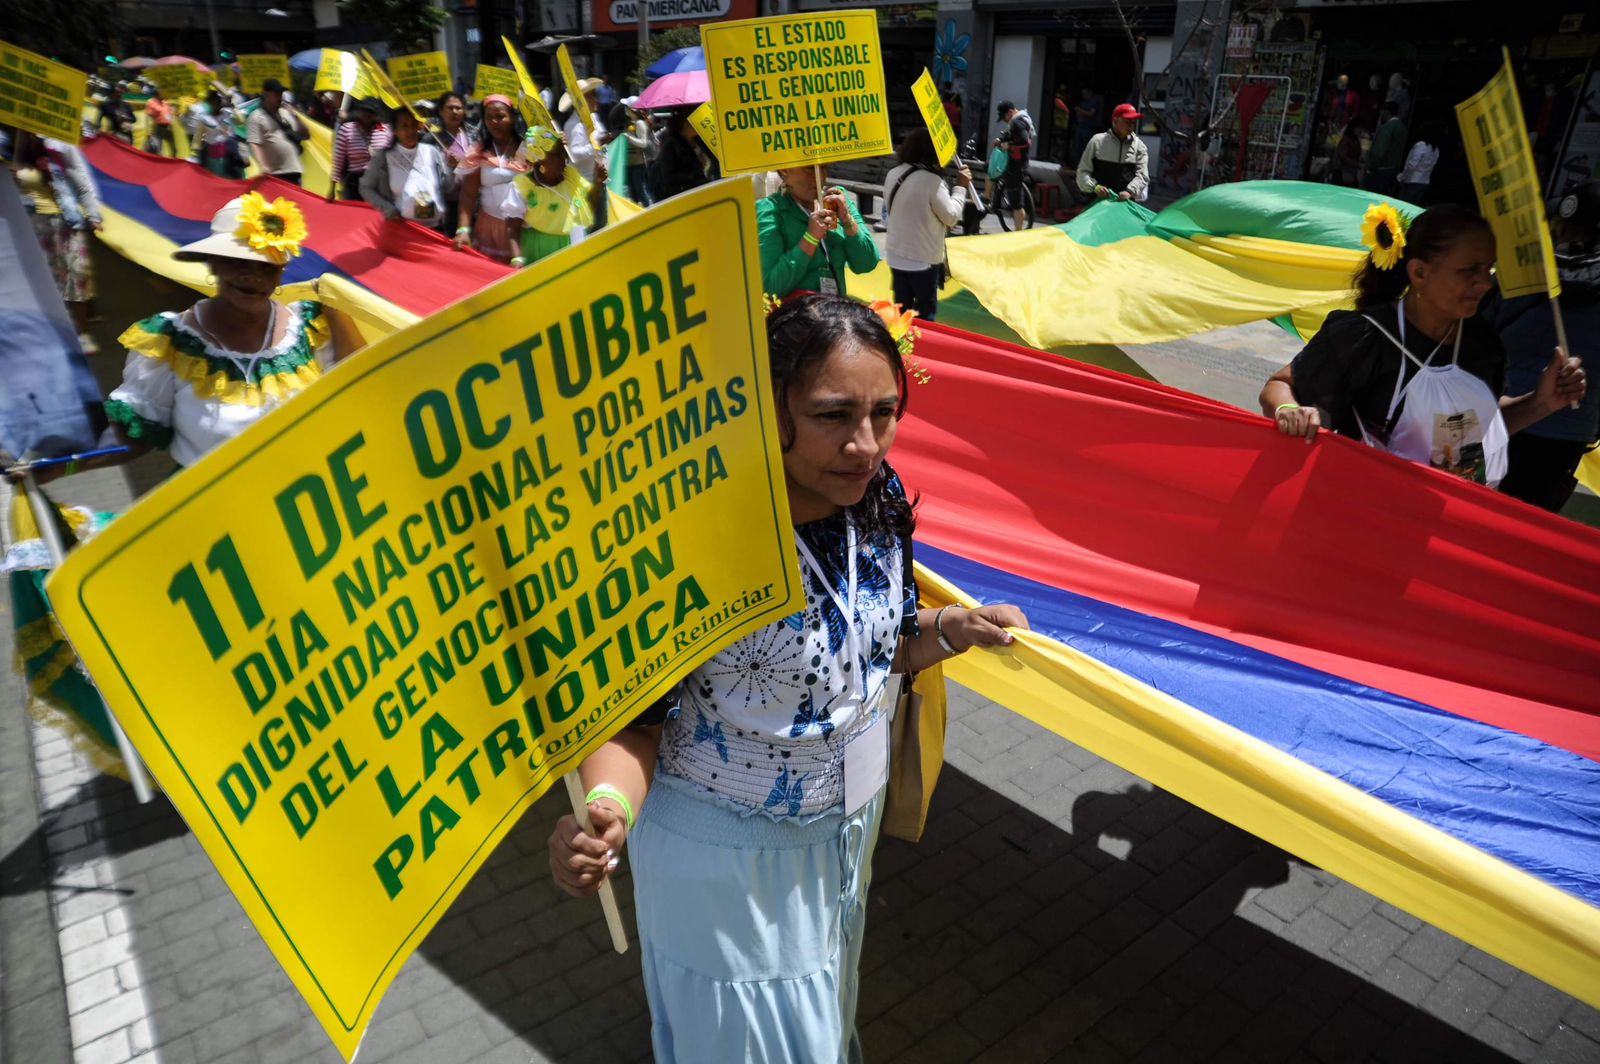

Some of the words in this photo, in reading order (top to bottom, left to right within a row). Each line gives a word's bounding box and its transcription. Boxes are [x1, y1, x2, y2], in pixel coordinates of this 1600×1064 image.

[616, 0, 721, 18] PANMERICANA
[723, 56, 747, 79] ES
[753, 44, 870, 75] RESPONSABLE
[755, 27, 776, 49] EL
[782, 20, 846, 45] ESTADO
[724, 102, 799, 131] CONTRA
[806, 99, 827, 121] LA
[832, 89, 880, 117] UNIÓN
[738, 80, 772, 104] DEL
[779, 70, 865, 98] GENOCIDIO
[761, 119, 859, 152] PATRIÓTICA
[854, 139, 885, 150] Reiniciar
[167, 533, 266, 662] 11
[273, 431, 388, 582] DE
[403, 250, 707, 480] OCTUBRE
[231, 608, 329, 717] DÍA
[332, 434, 562, 625] NACIONAL
[572, 377, 644, 456] POR
[655, 343, 704, 403] LA
[216, 596, 420, 826] DIGNIDAD
[427, 542, 484, 615] DE
[496, 486, 570, 570] LAS
[579, 376, 748, 506] VÍCTIMAS
[280, 738, 368, 841] DEL
[372, 547, 579, 740] GENOCIDIO
[590, 445, 728, 563] CONTRA
[375, 711, 465, 818] LA
[481, 529, 675, 706] UNIÓN
[528, 651, 668, 771] Corporación
[672, 582, 773, 652] Reiniciar
[373, 574, 710, 902] PATRIÓTICA
